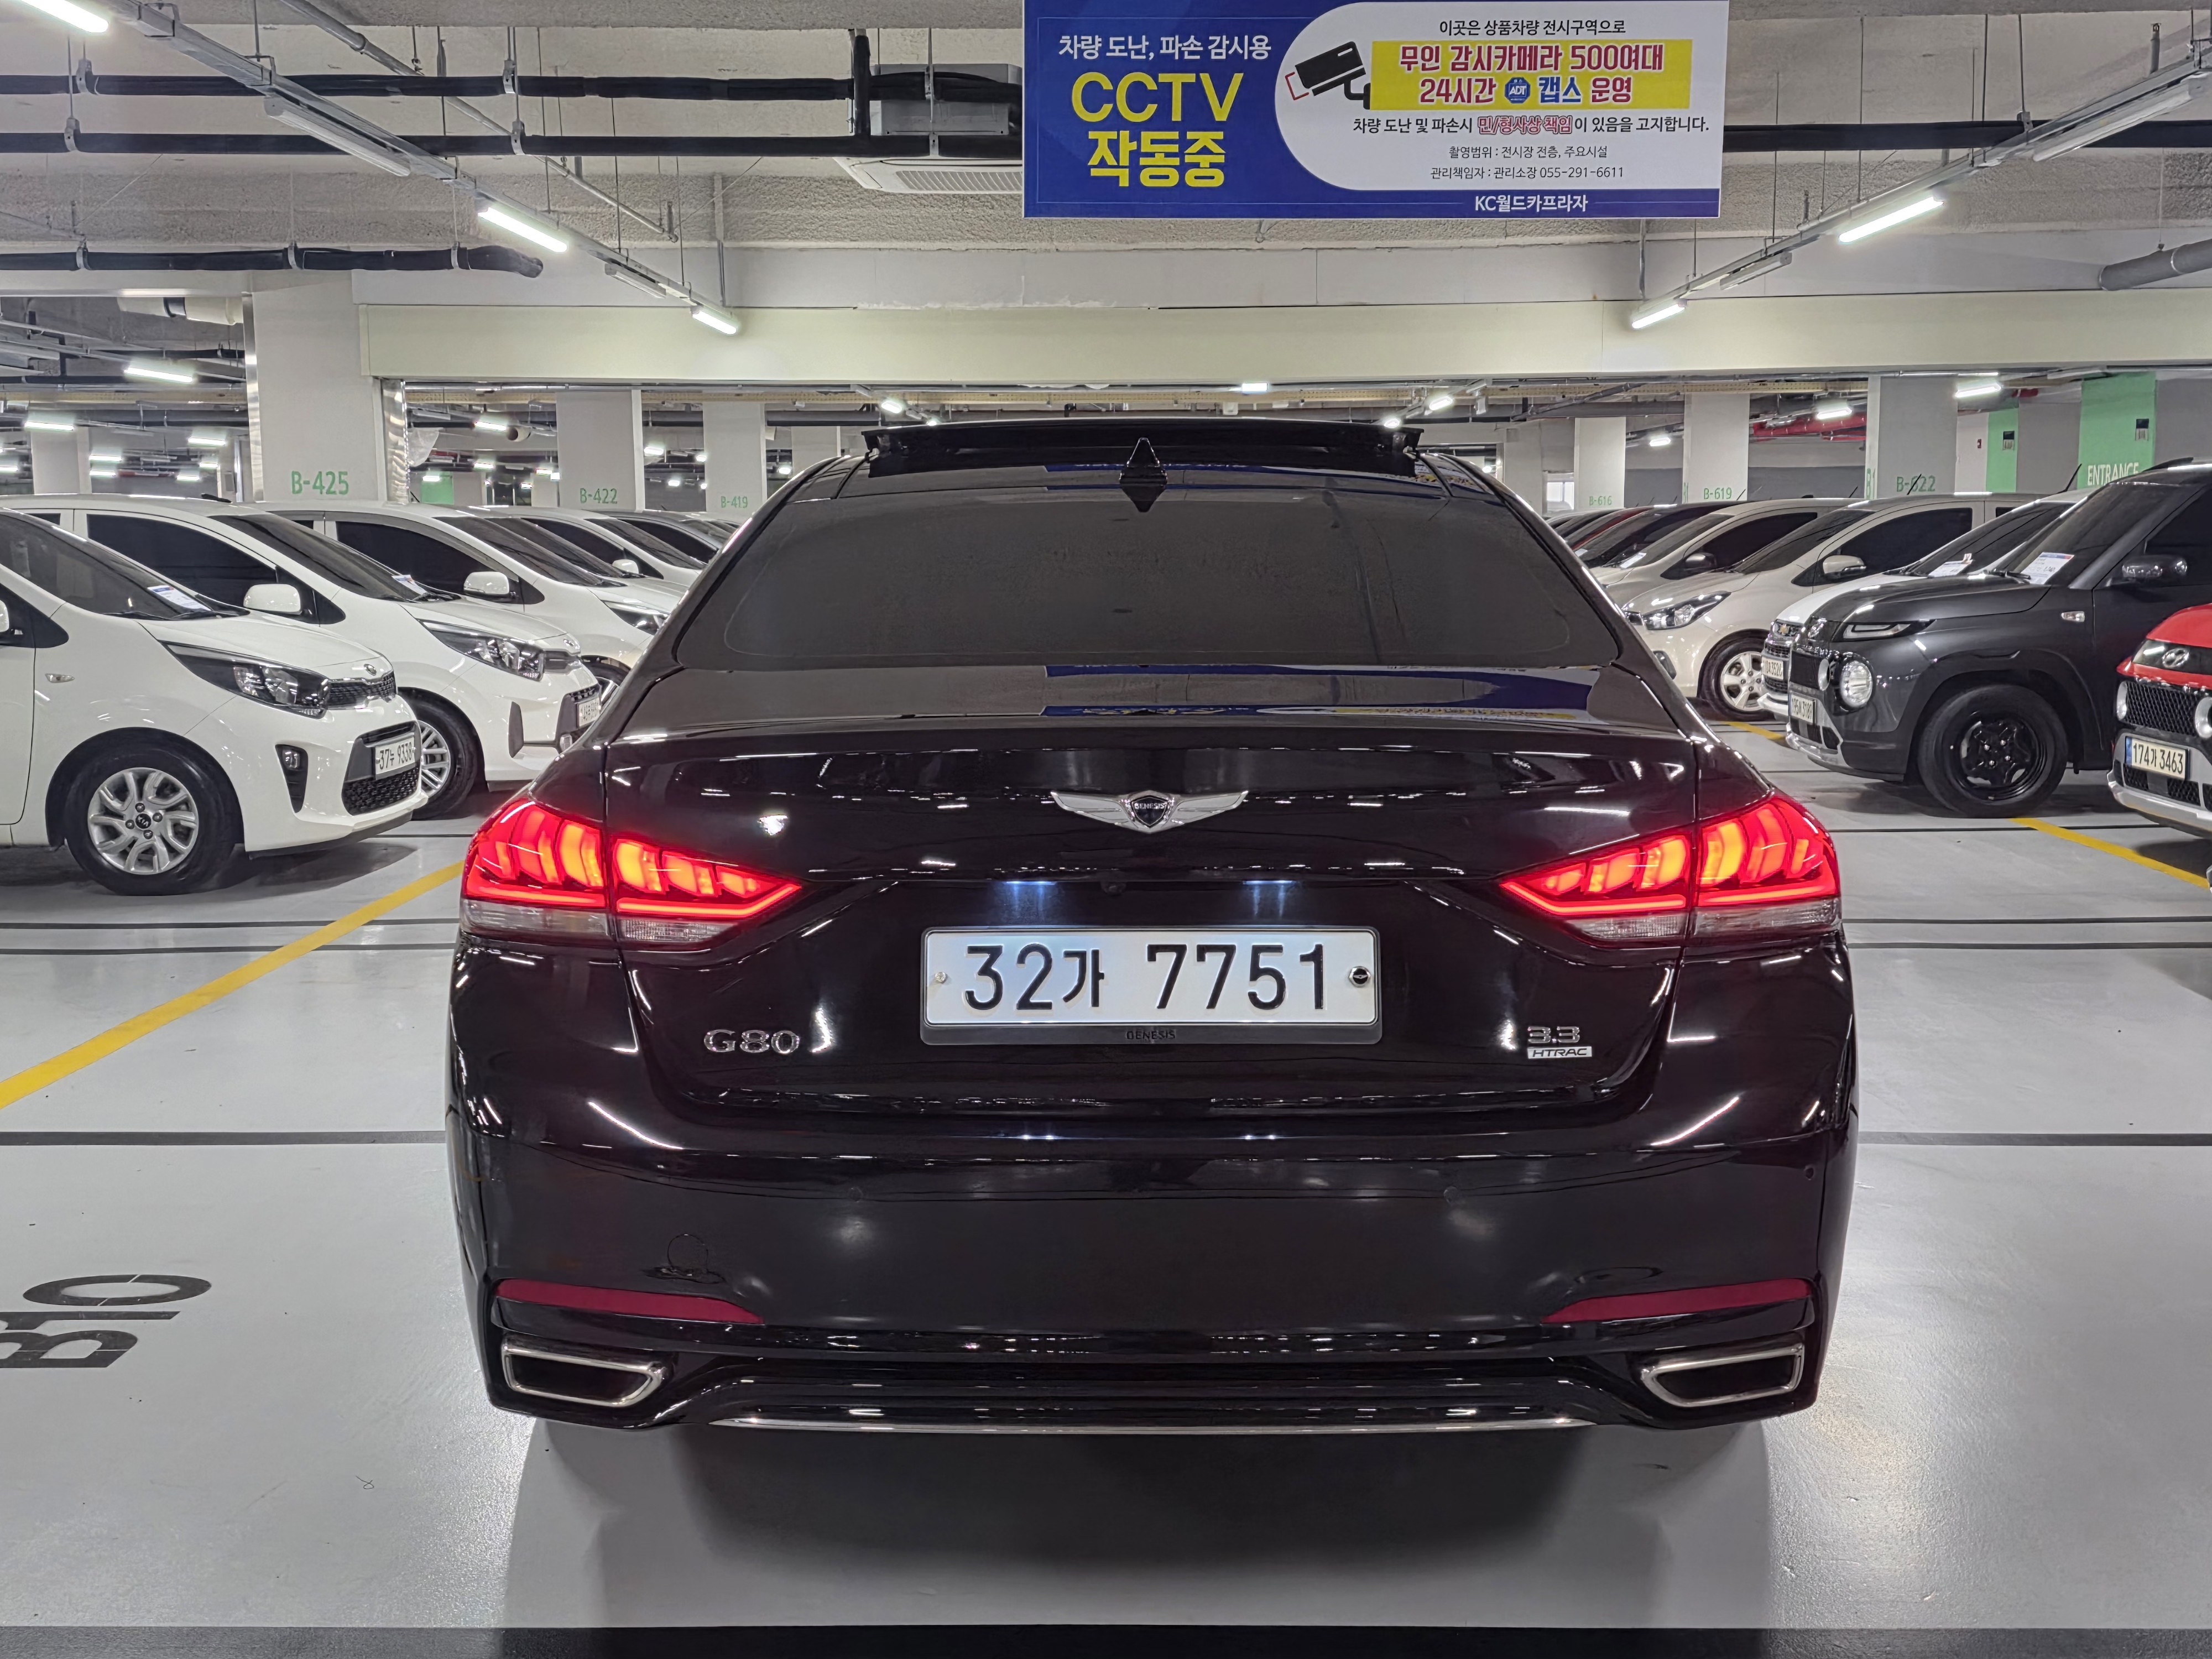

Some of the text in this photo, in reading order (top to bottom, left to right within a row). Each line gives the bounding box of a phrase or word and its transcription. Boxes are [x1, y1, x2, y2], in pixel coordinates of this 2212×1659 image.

[1439, 19, 1626, 36] 이곳은 상품차량 전시구역으로
[1058, 34, 1271, 60] 차량 도난, 파손 감시용
[1400, 44, 1664, 71] 무인 감시카메라 500여대
[1072, 72, 1244, 122] CCTV
[1420, 76, 1631, 104] 24시간 ADT 캡스 운영
[1353, 118, 1381, 134] 차량
[1384, 118, 1412, 134] 도난
[1415, 118, 1428, 133] 및
[1431, 118, 1473, 133] 파손시
[1477, 116, 1541, 134] 민/형사상
[1592, 117, 1633, 133] 있음을
[1635, 116, 1710, 133] 고지합니다.
[1087, 130, 1227, 187] 작동중
[1449, 146, 1492, 159] 촬영범위
[1501, 146, 1533, 159] 전시장
[1536, 145, 1561, 159] 전층,
[1564, 145, 1608, 159] 주요시설
[1431, 166, 1485, 180] 관리책임자
[1493, 166, 1537, 179] 관리소장
[1540, 166, 1624, 179] 055-291-6611
[1474, 194, 1589, 212] KC월드카프라자
[291, 471, 349, 495] B-425
[1896, 475, 1936, 492] B-622
[580, 488, 618, 504] B-422
[721, 495, 748, 508] B-419
[1589, 495, 1613, 505] B-616
[1704, 487, 1732, 499] B-619
[397, 742, 413, 765] 9338
[2133, 743, 2183, 774] 174가 3463
[964, 942, 1325, 1011] 32가 7751
[703, 1029, 801, 1054] G80
[1126, 1030, 1176, 1040] GENESIS
[1527, 1026, 1580, 1044] 3.3
[1532, 1048, 1588, 1057] HTRAC
